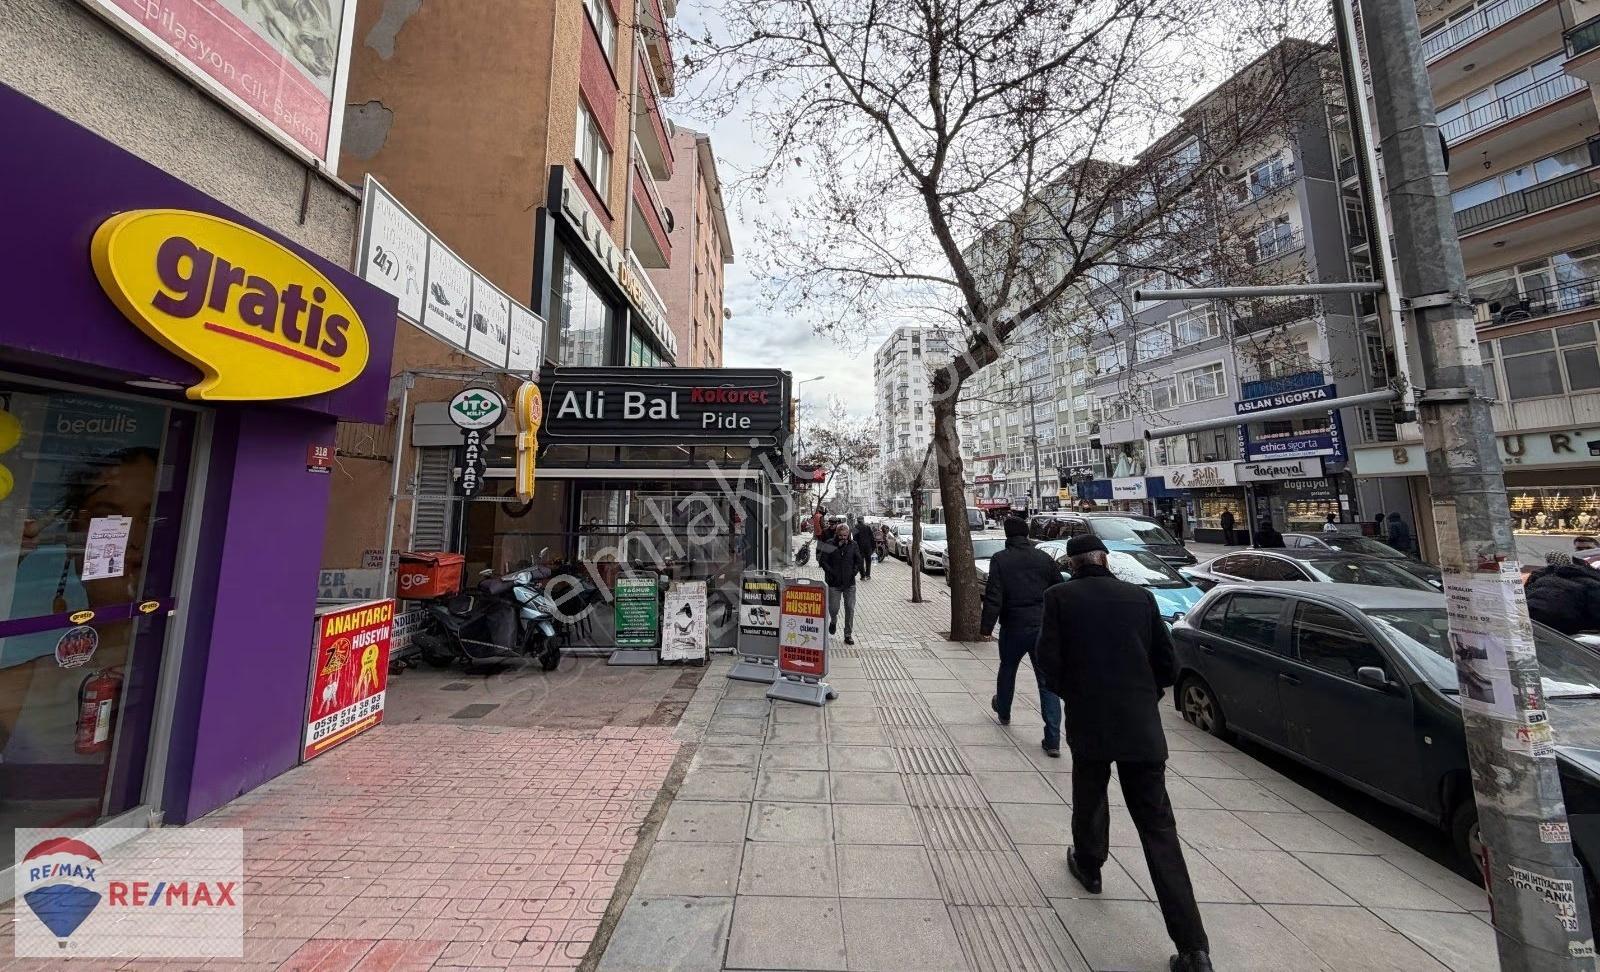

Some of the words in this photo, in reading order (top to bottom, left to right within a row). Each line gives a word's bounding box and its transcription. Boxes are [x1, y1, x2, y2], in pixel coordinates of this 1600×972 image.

[240, 72, 269, 106] Cilt
[151, 236, 350, 358] gratis
[556, 390, 605, 419] Ali
[624, 391, 680, 420] Bal
[1238, 400, 1272, 412] ASLAN
[1274, 389, 1326, 405] SİGORTA
[702, 412, 751, 428] Pide
[314, 446, 328, 456] 318
[1260, 442, 1286, 452] ethica
[1288, 440, 1318, 452] sigorta
[462, 430, 480, 496] ANAHTARCI
[326, 604, 392, 637] ANAHTARCI
[352, 625, 390, 650] HÜSEYİN
[313, 724, 337, 740] 0312
[340, 714, 356, 728] 336
[358, 709, 368, 718] 45
[314, 714, 338, 731] 0538
[340, 705, 357, 718] 514
